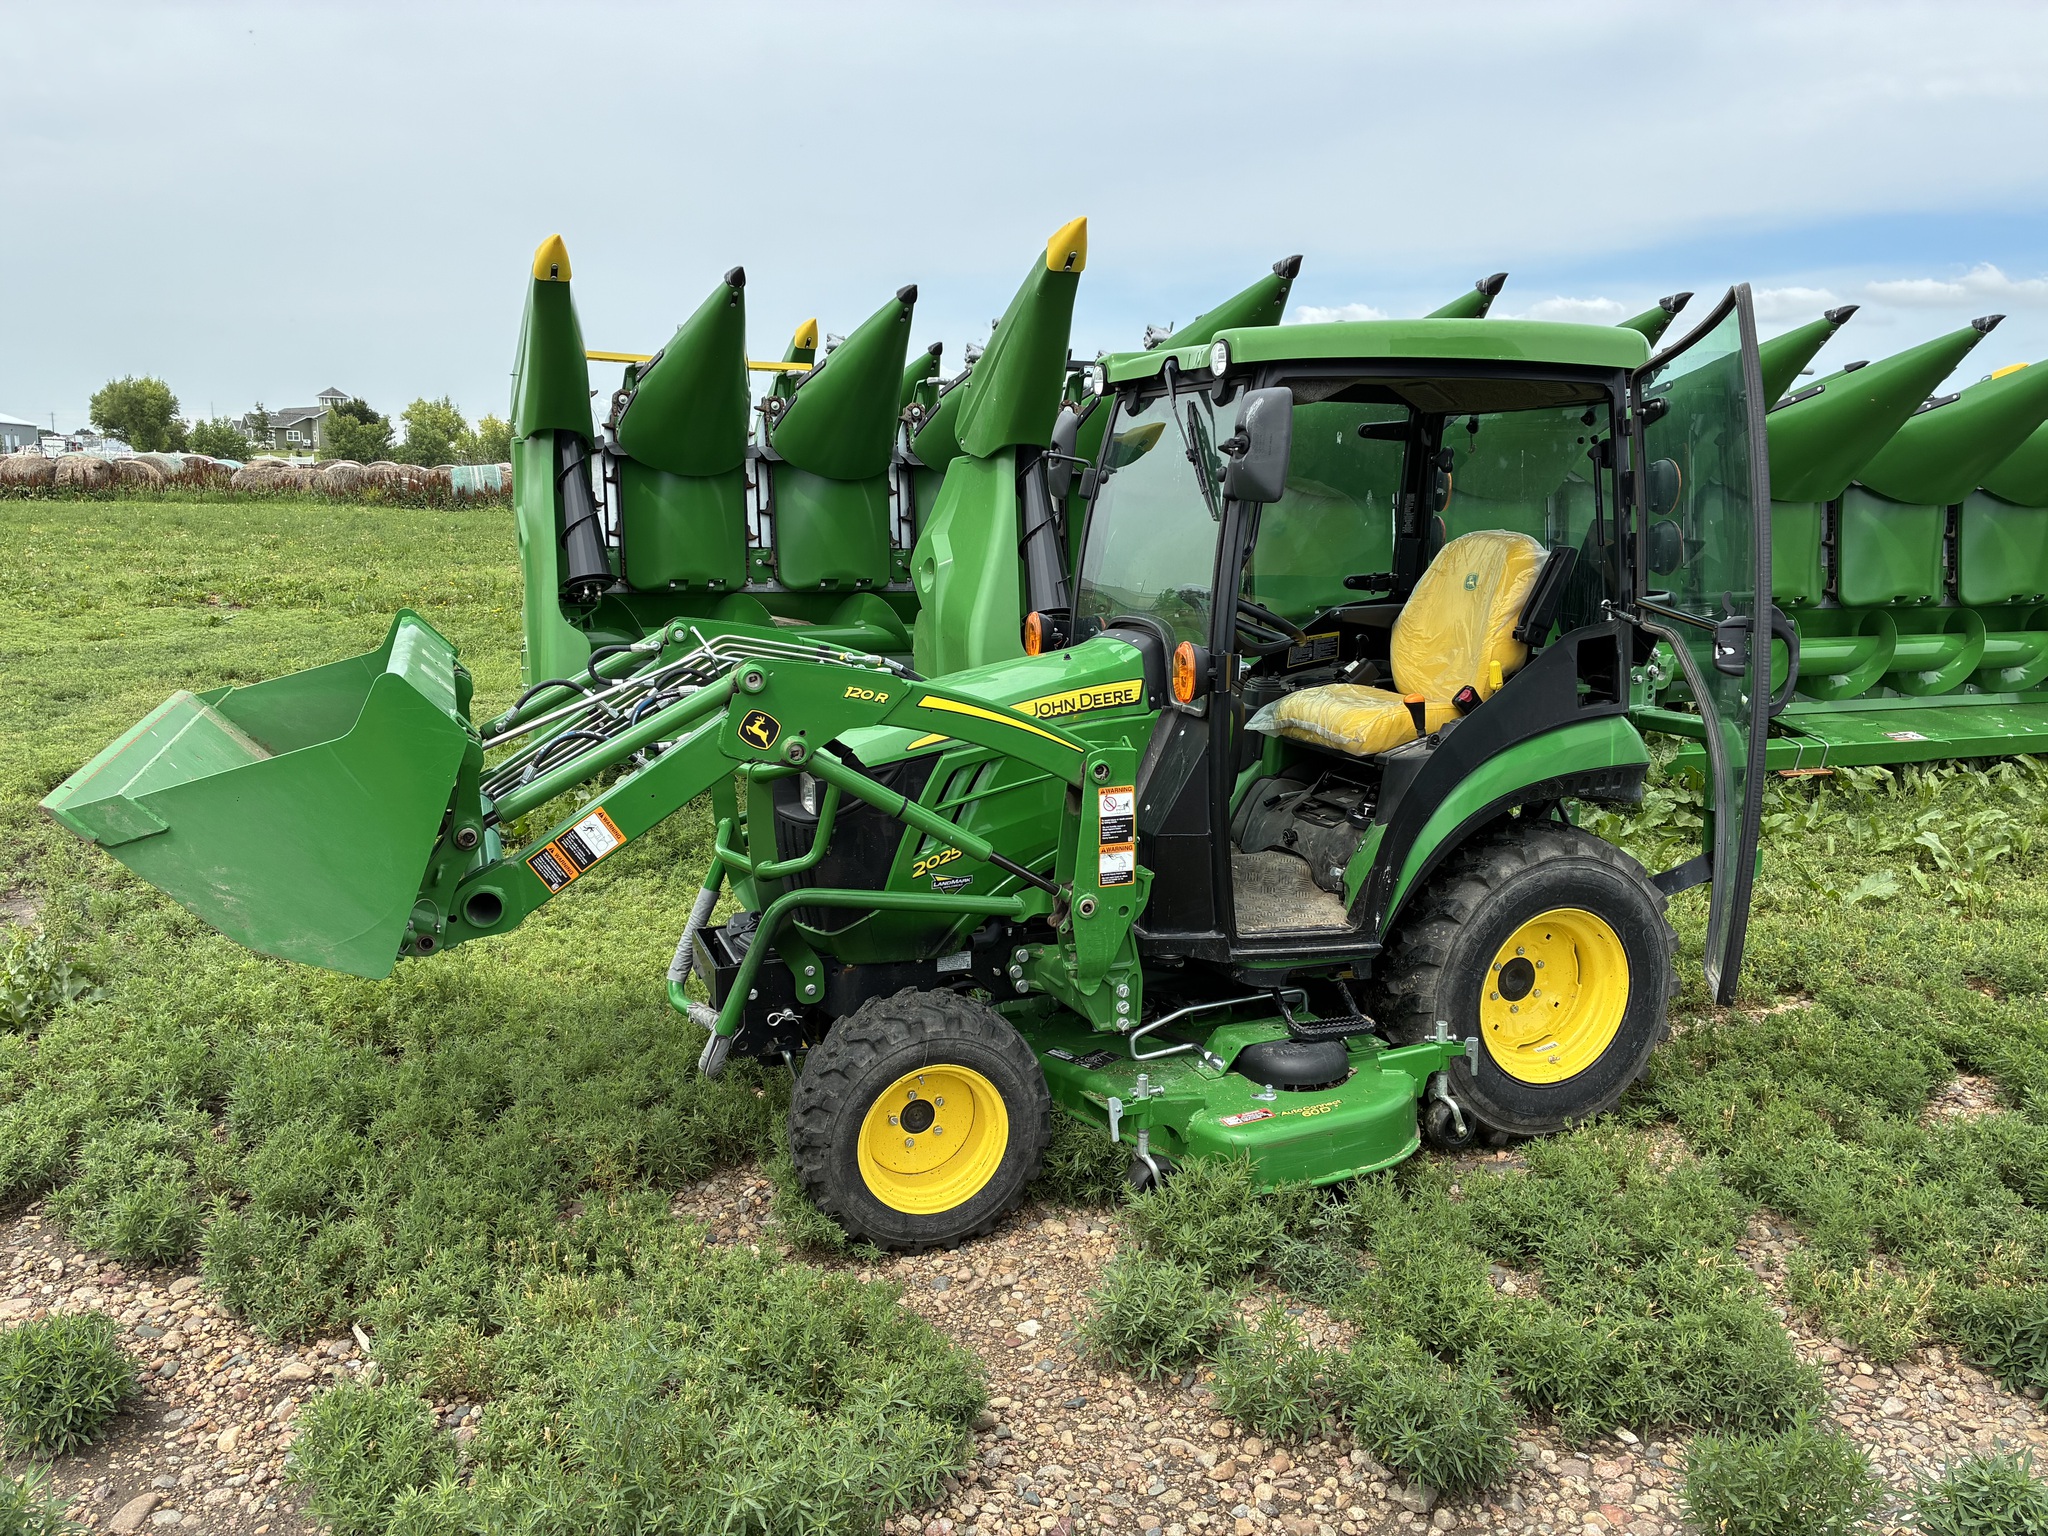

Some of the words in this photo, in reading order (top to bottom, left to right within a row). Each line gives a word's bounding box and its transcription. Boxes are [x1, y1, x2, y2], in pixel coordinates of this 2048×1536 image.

[1033, 697, 1076, 717] JOHN
[1079, 689, 1134, 708] DEERE
[603, 816, 621, 840] WARNING
[1106, 845, 1132, 853] WARNING
[555, 853, 574, 875] WARNING
[912, 847, 963, 878] 2025
[1281, 1099, 1342, 1116] AutoConnect
